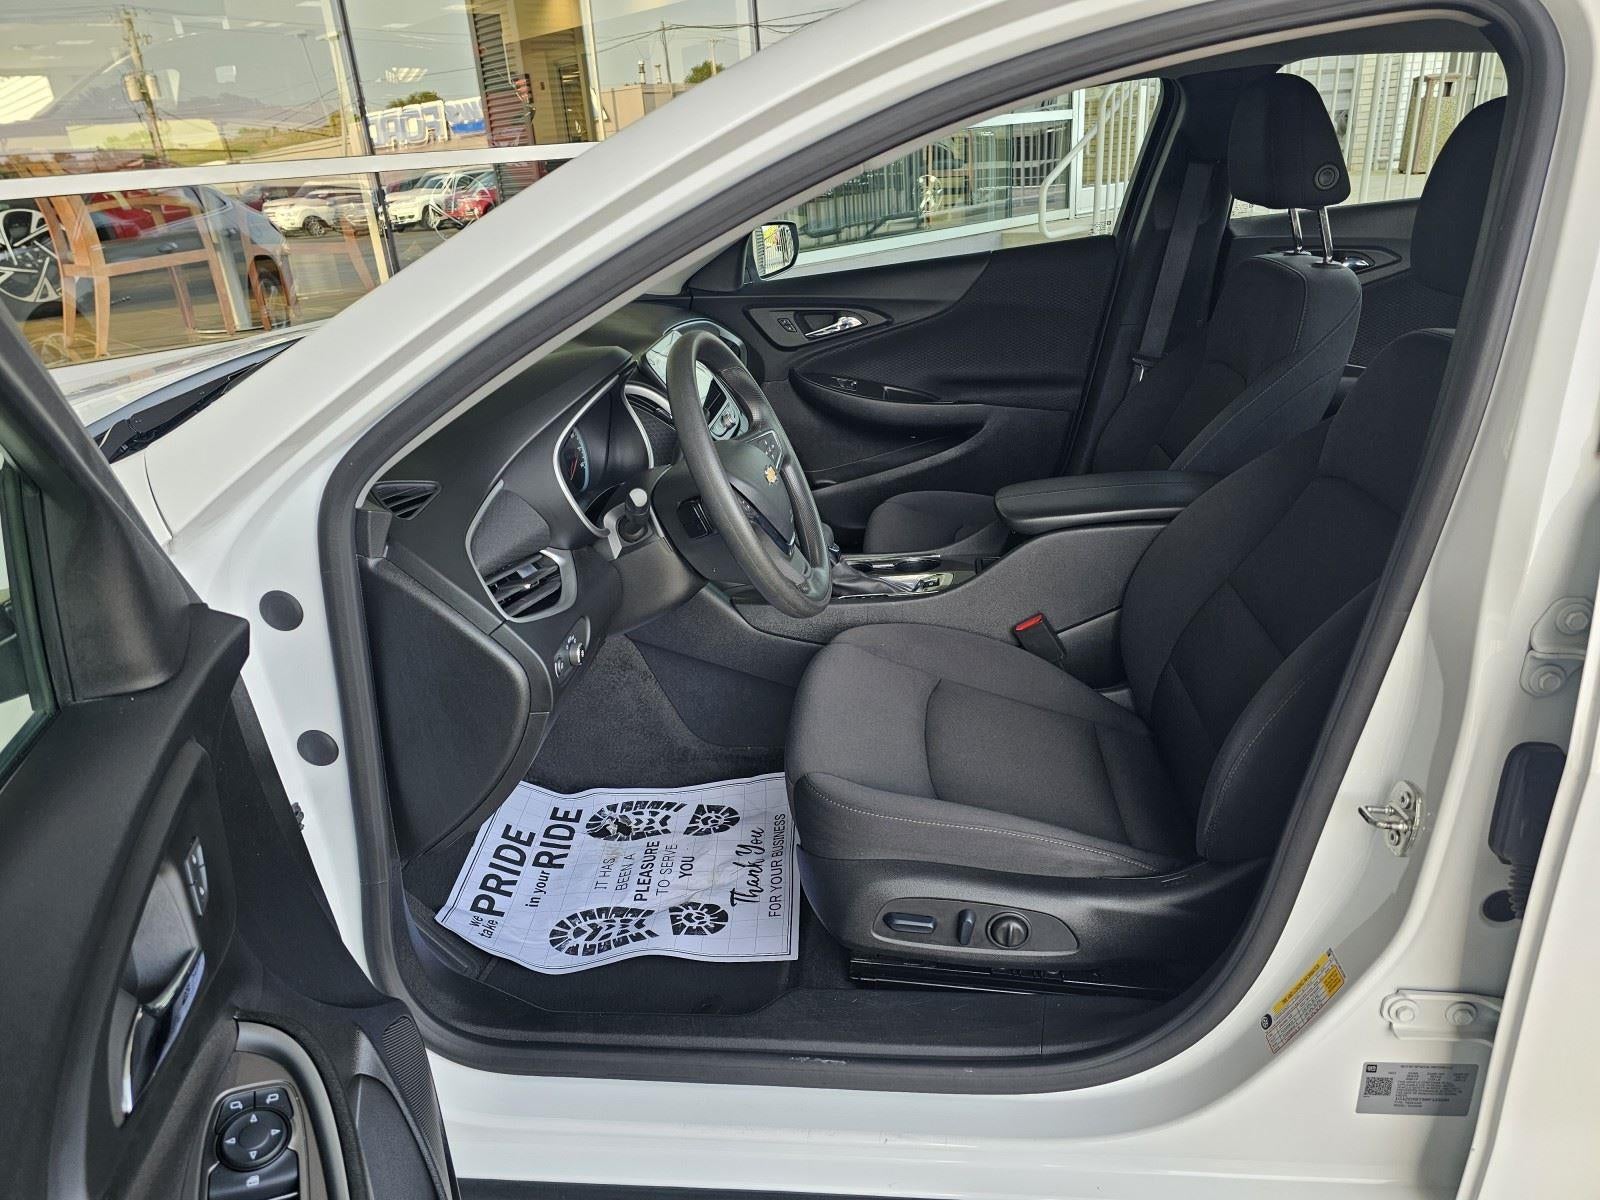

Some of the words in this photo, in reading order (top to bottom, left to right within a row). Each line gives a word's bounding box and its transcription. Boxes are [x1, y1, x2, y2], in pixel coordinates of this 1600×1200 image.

[531, 806, 583, 869] RIDE
[735, 827, 765, 856] You
[771, 813, 786, 858] BUSINESS
[469, 823, 536, 917] PRIDE
[599, 857, 616, 878] HAS
[633, 840, 660, 901] PLEASURE
[660, 844, 678, 875] SERVE
[678, 856, 695, 879] YOU
[533, 870, 550, 894] your
[594, 880, 609, 890] IT
[615, 863, 633, 891] BEEN
[656, 879, 670, 896] TO
[729, 858, 765, 907] Thank
[770, 859, 783, 892] YOUR
[525, 896, 541, 907] in
[769, 894, 782, 917] FOR
[469, 915, 483, 927] we
[478, 920, 498, 938] take
